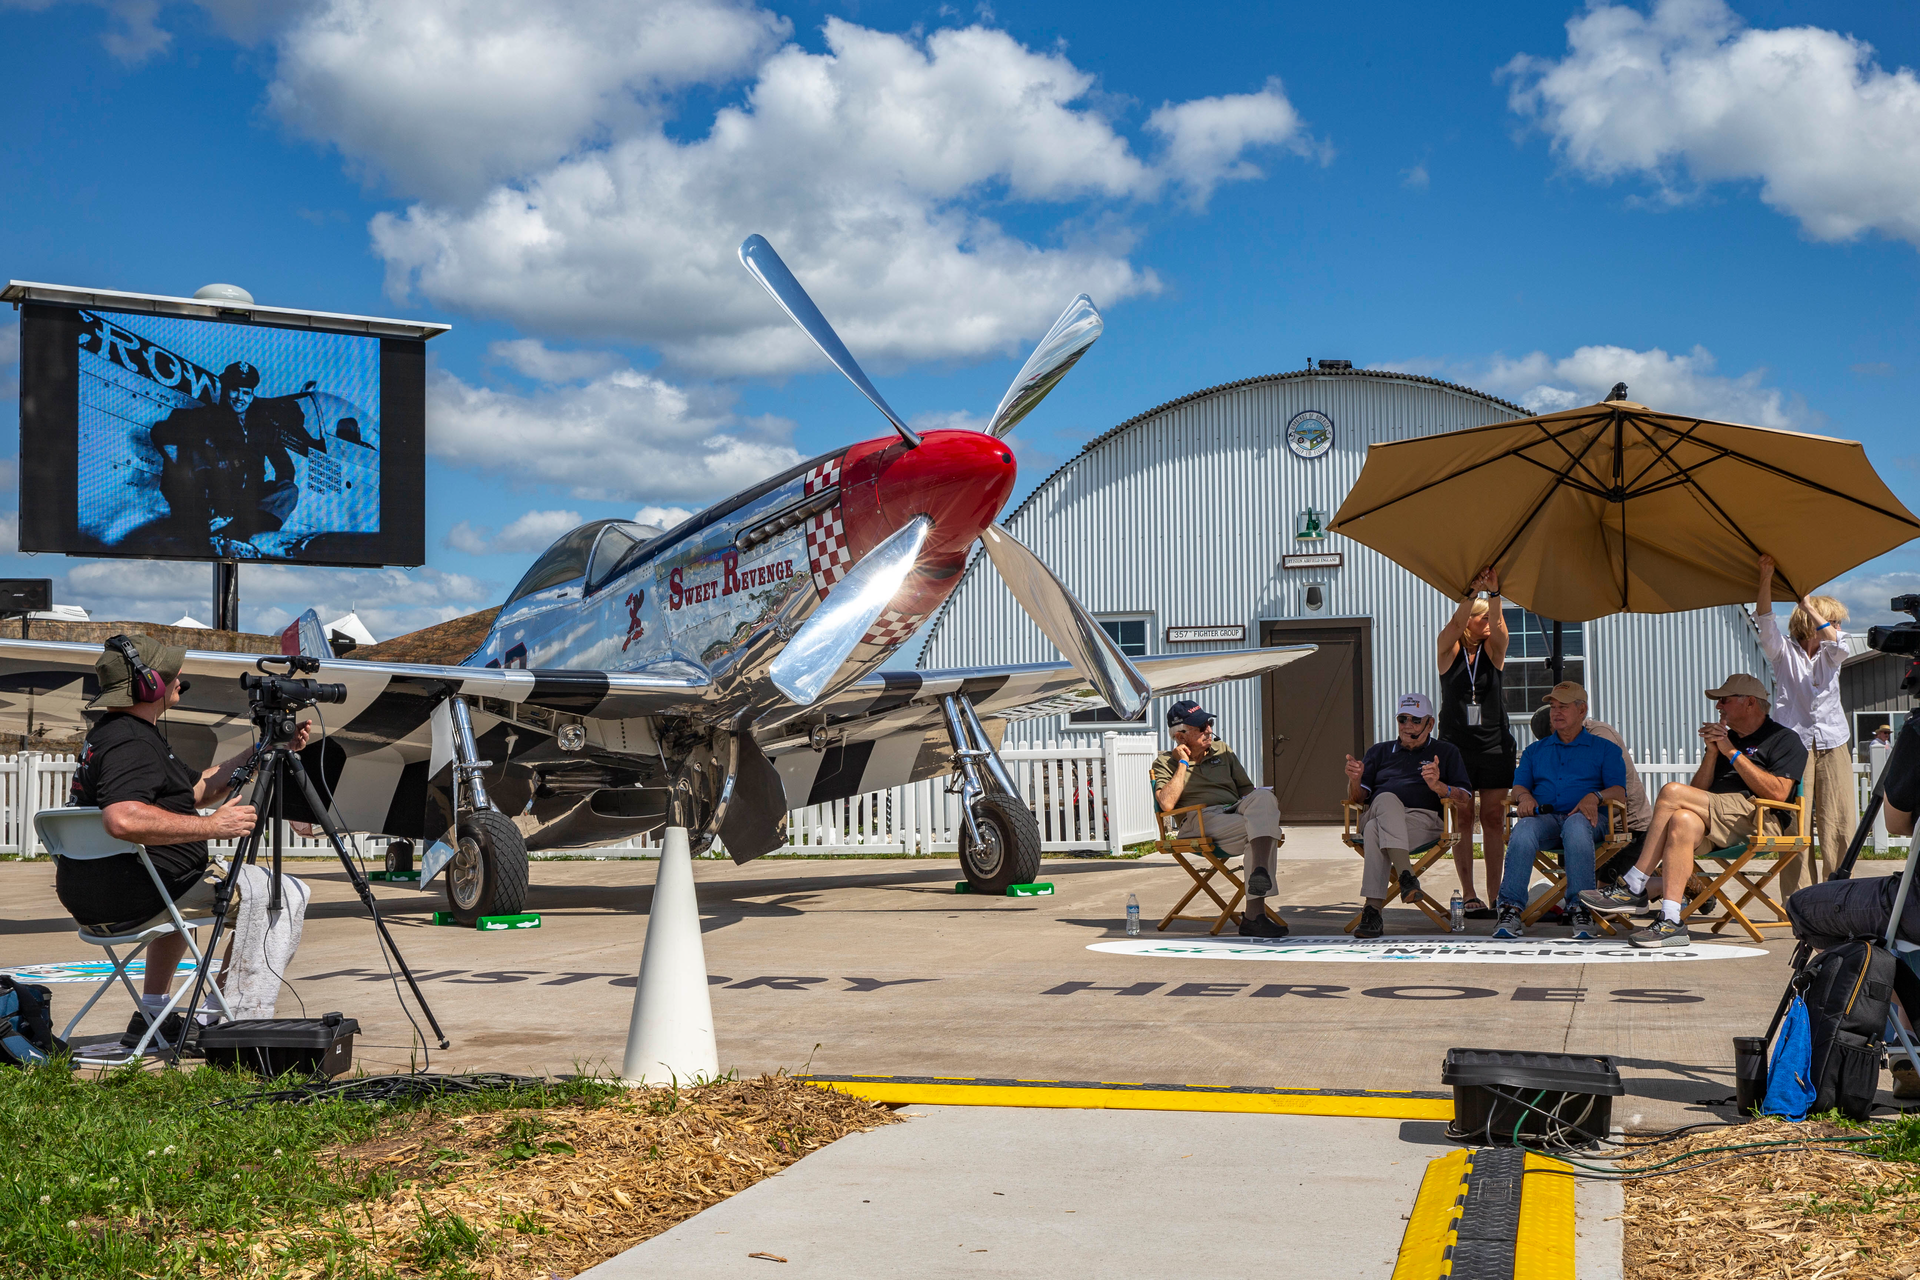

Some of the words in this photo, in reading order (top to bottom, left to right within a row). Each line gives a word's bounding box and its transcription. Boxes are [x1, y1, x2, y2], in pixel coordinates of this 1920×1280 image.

[669, 567, 718, 611] SWEET
[721, 551, 793, 596] REVENGE
[1220, 629, 1239, 637] GROUP
[1383, 947, 1699, 957] Miracle-Gro
[1039, 981, 1705, 1004] HEROES
